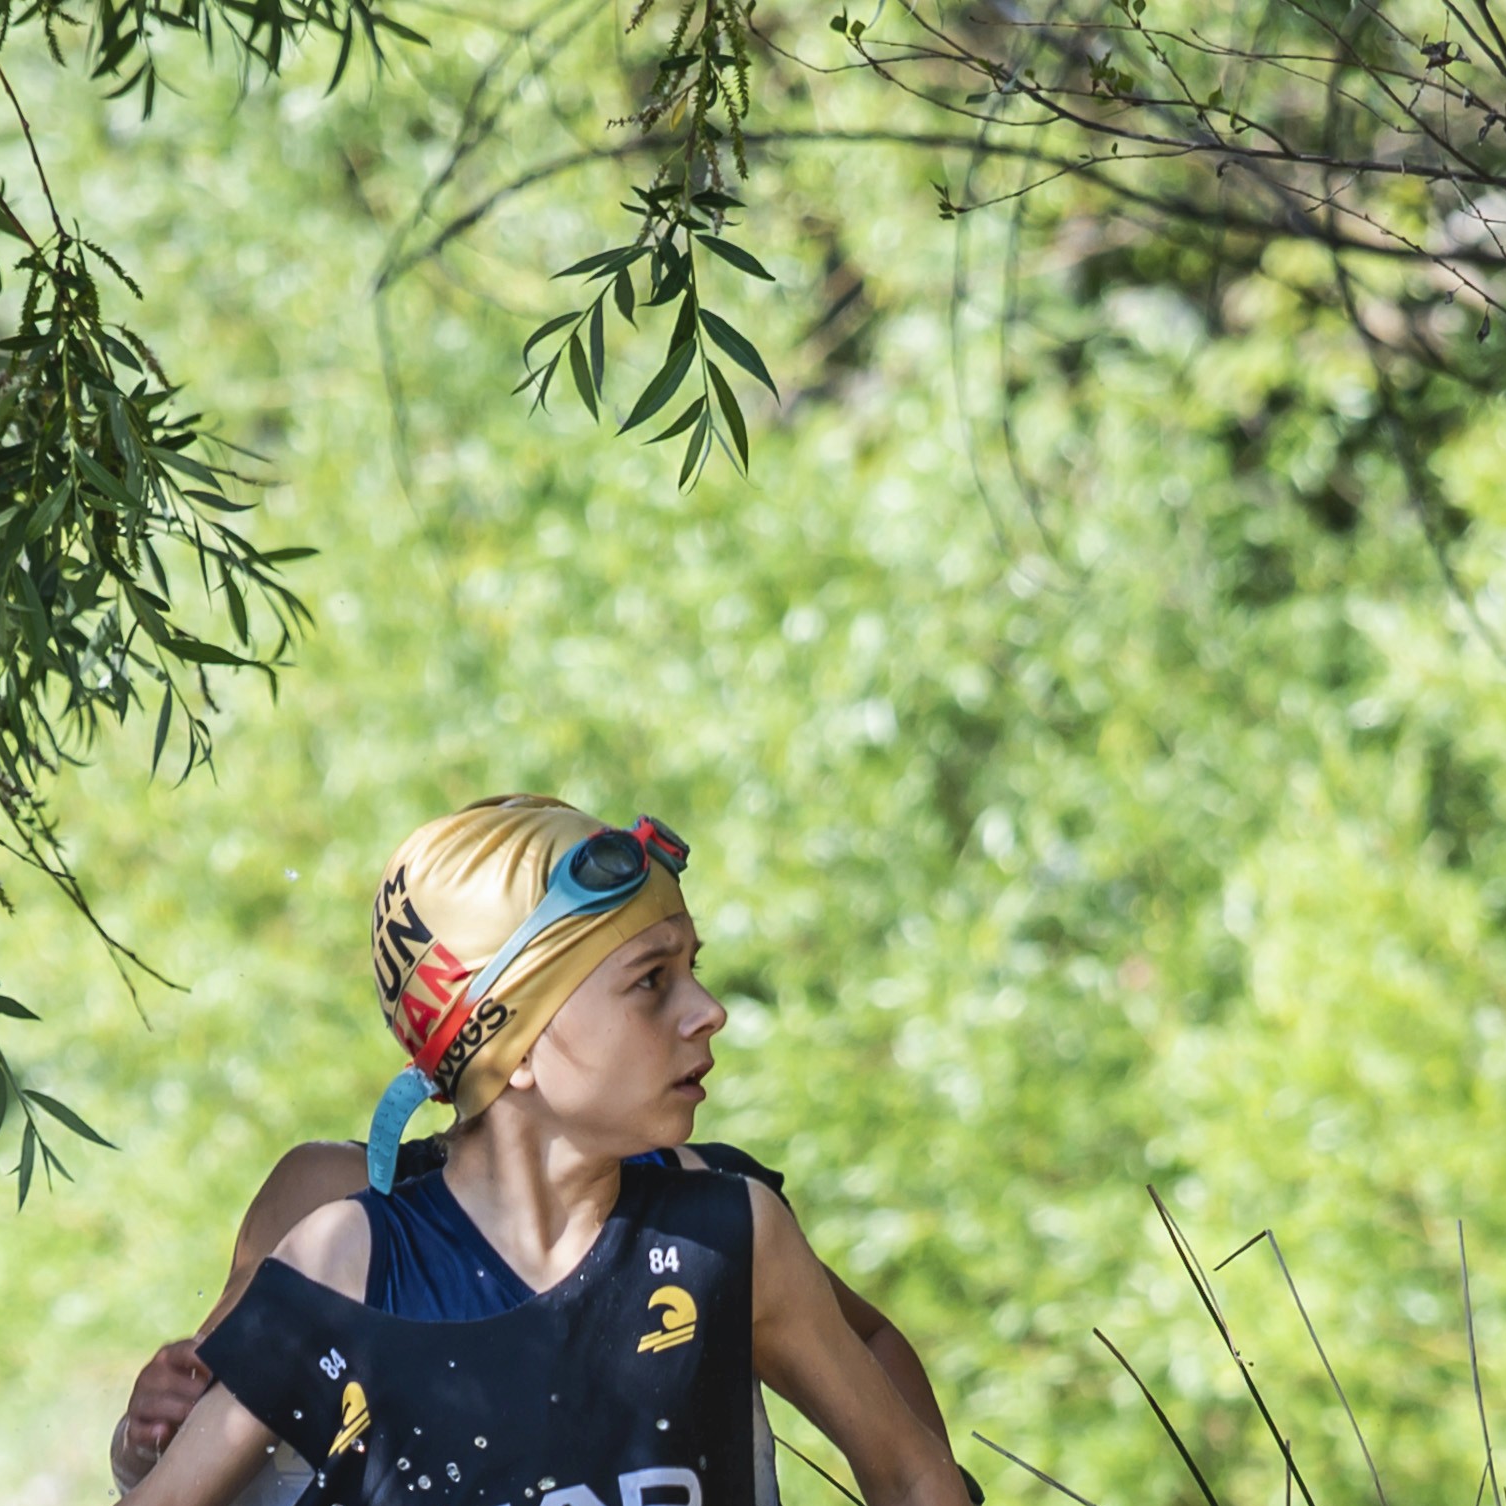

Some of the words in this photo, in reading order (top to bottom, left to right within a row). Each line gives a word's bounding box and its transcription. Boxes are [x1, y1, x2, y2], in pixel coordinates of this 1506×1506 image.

[375, 897, 434, 1029] UN
[434, 997, 509, 1093] OGGS
[648, 1245, 681, 1275] 84
[319, 1347, 347, 1380] 84
